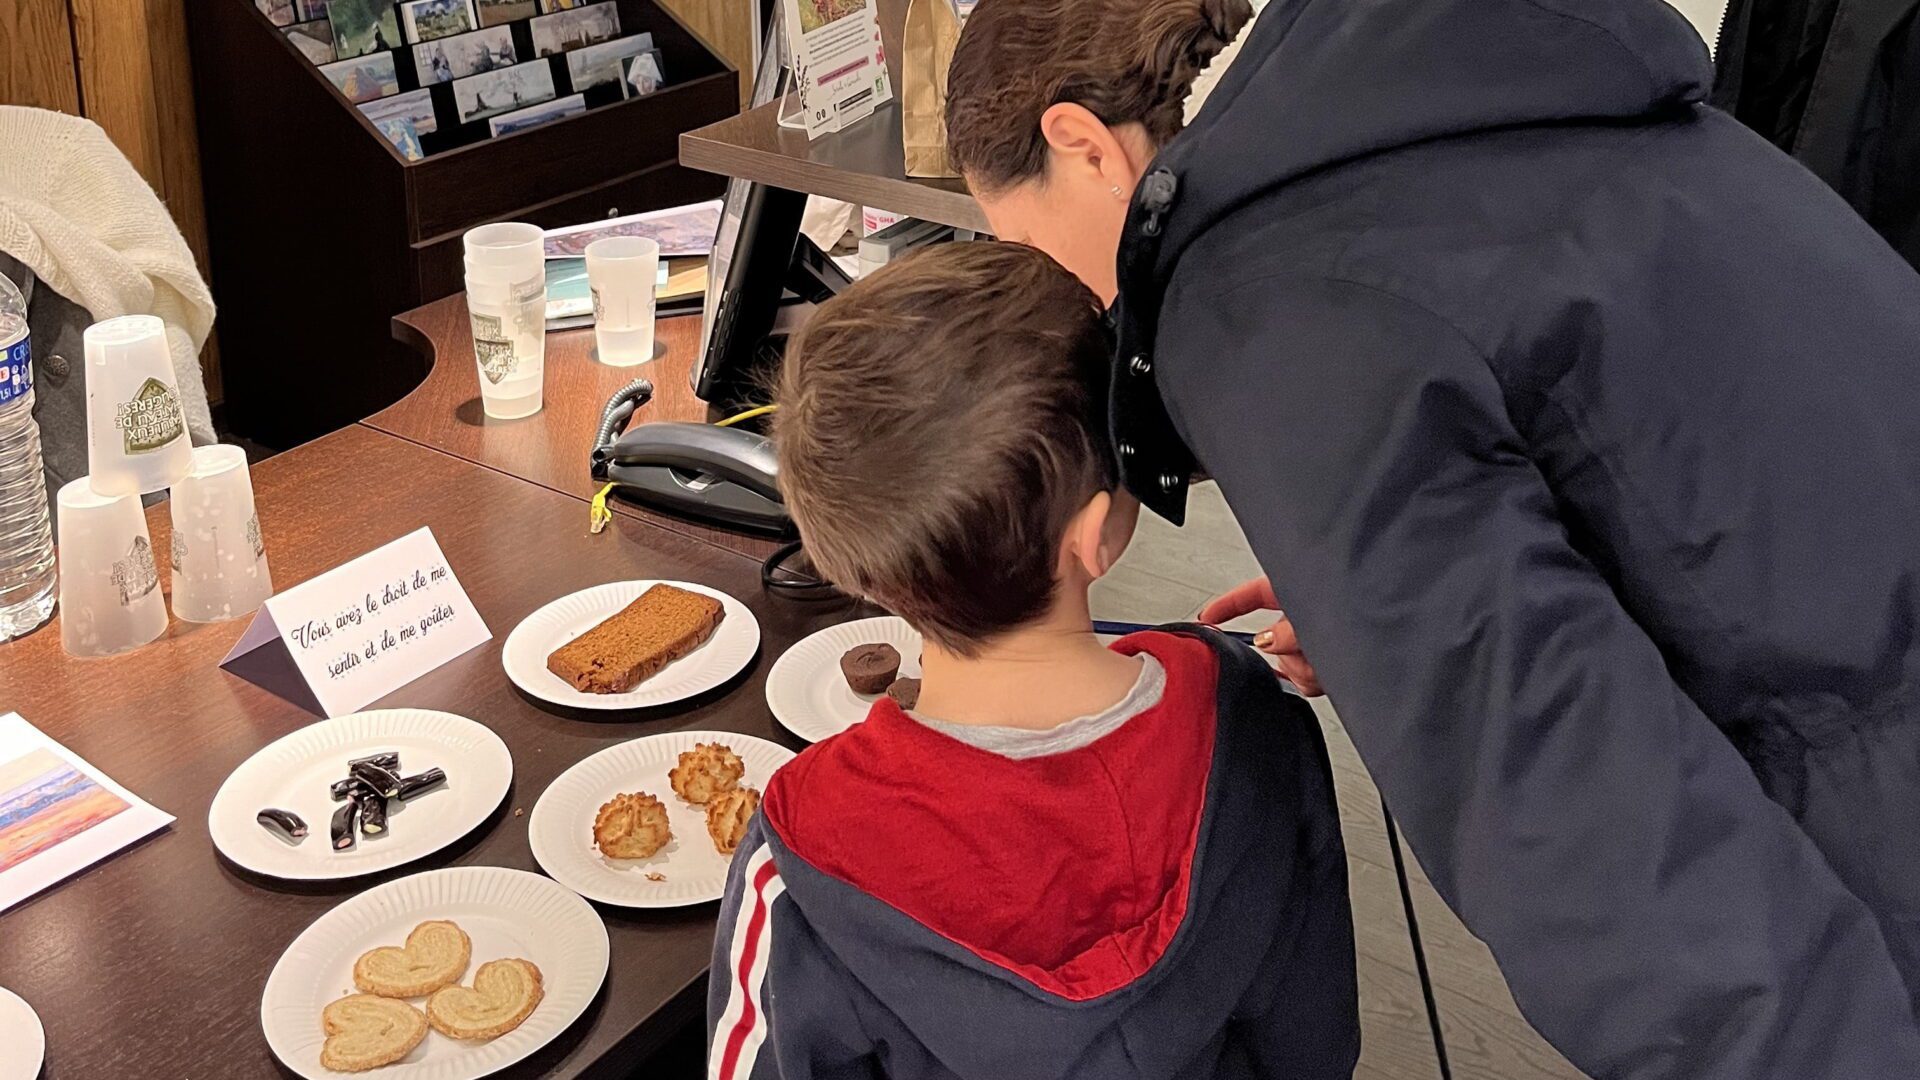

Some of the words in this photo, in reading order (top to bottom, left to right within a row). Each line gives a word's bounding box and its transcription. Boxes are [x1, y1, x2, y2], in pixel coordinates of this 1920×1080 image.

[114, 416, 132, 430] DE
[290, 620, 332, 649] Vous
[336, 608, 362, 629] avez
[366, 593, 379, 613] le
[382, 581, 409, 606] droit
[413, 569, 427, 590] de
[431, 566, 446, 582] me
[328, 652, 361, 678] sentir
[365, 641, 378, 659] et
[381, 629, 396, 651] de
[400, 625, 416, 641] me
[420, 604, 455, 637] goûter
